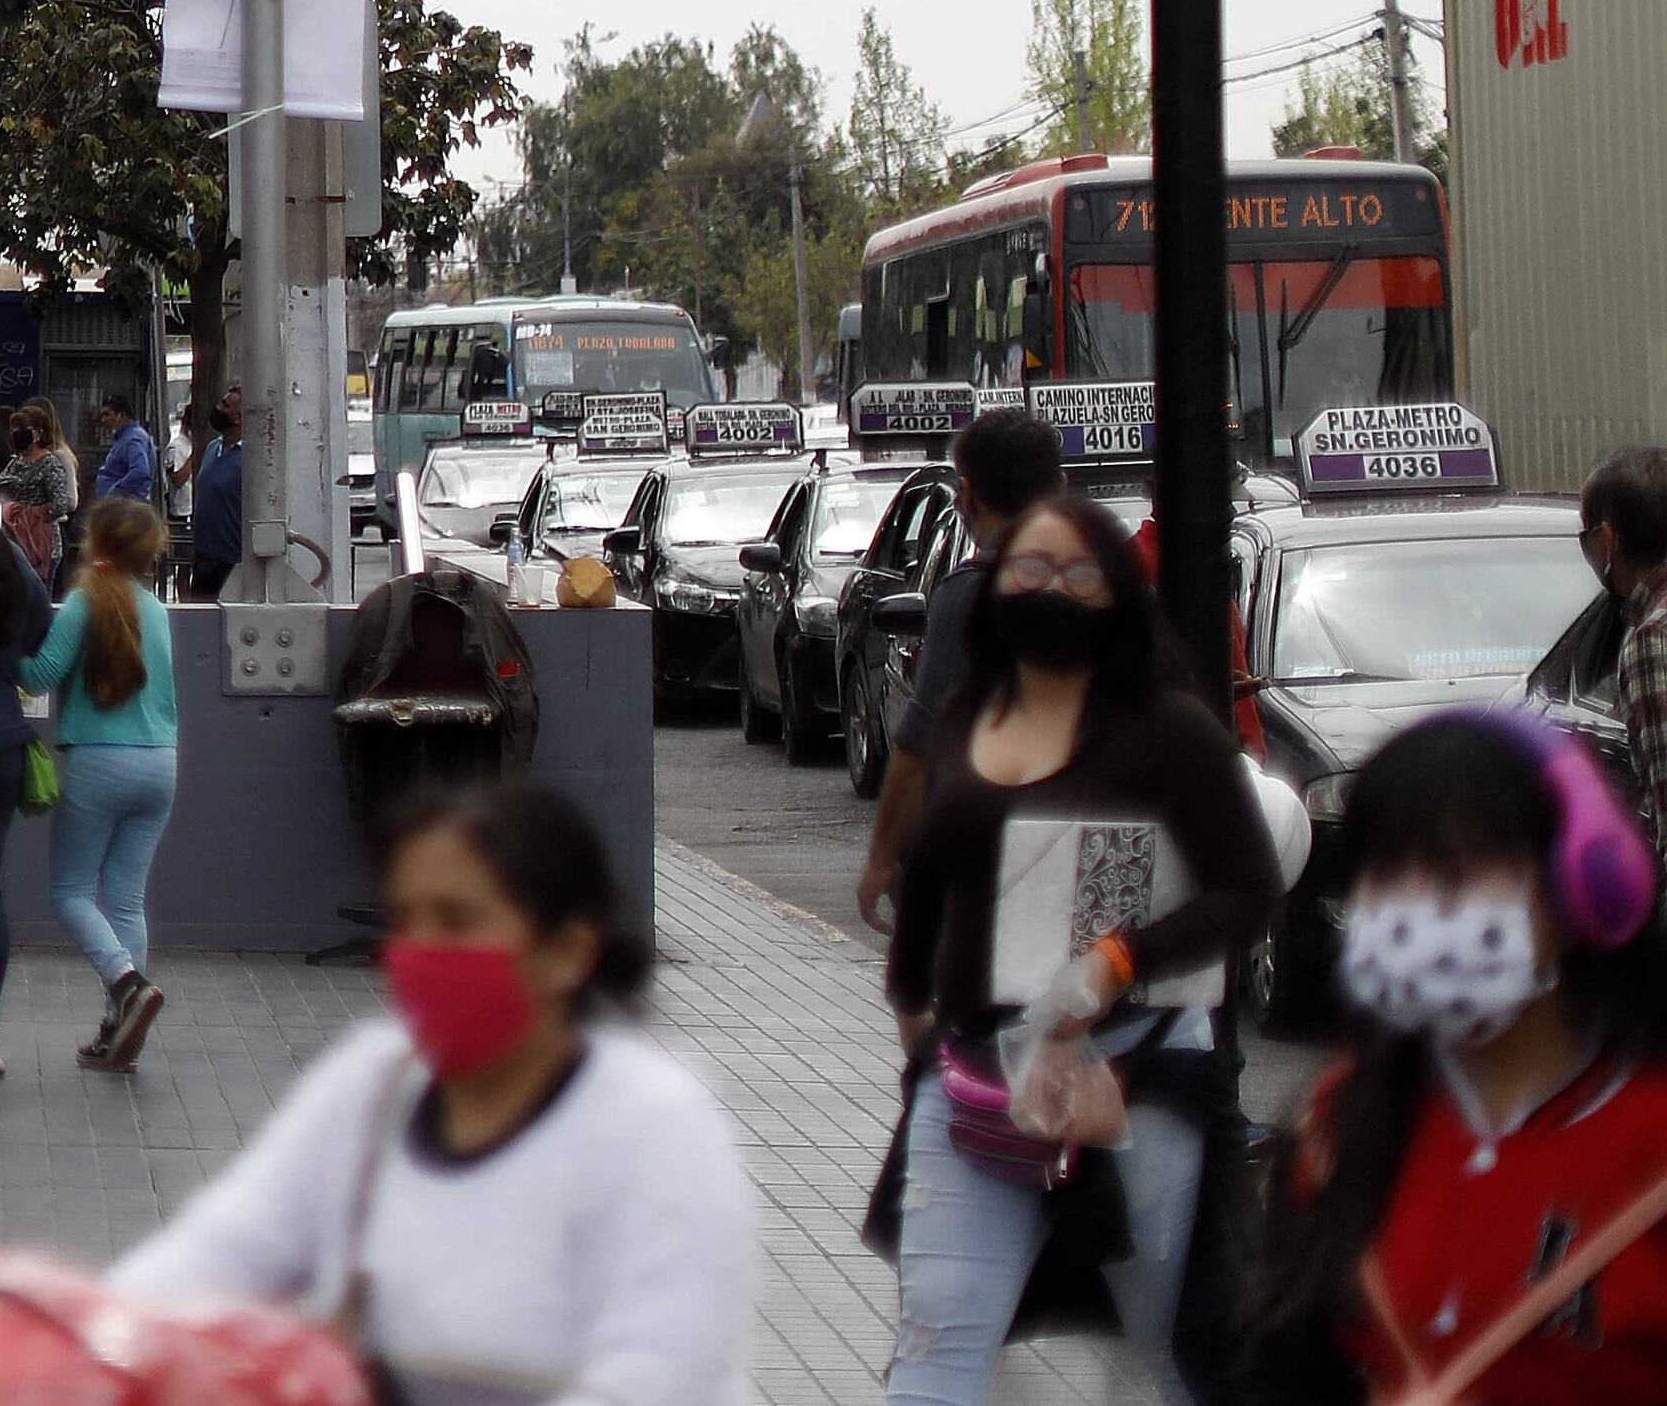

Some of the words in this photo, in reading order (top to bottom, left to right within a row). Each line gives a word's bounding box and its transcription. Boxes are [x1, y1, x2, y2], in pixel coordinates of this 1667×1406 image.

[1225, 194, 1289, 229] NTE
[1302, 194, 1384, 227] ALTO
[1037, 388, 1086, 407] CAMINO
[1087, 386, 1154, 405] INTERNACI
[889, 416, 951, 430] 4002
[1122, 404, 1155, 422] GERO
[1328, 405, 1462, 431] PLAZA-METRO
[612, 423, 660, 434] GERONIMO
[719, 428, 772, 441] 4002
[1084, 427, 1142, 451] 4016
[1315, 427, 1481, 451] SN.GERONIMO
[1368, 456, 1438, 478] 4036
